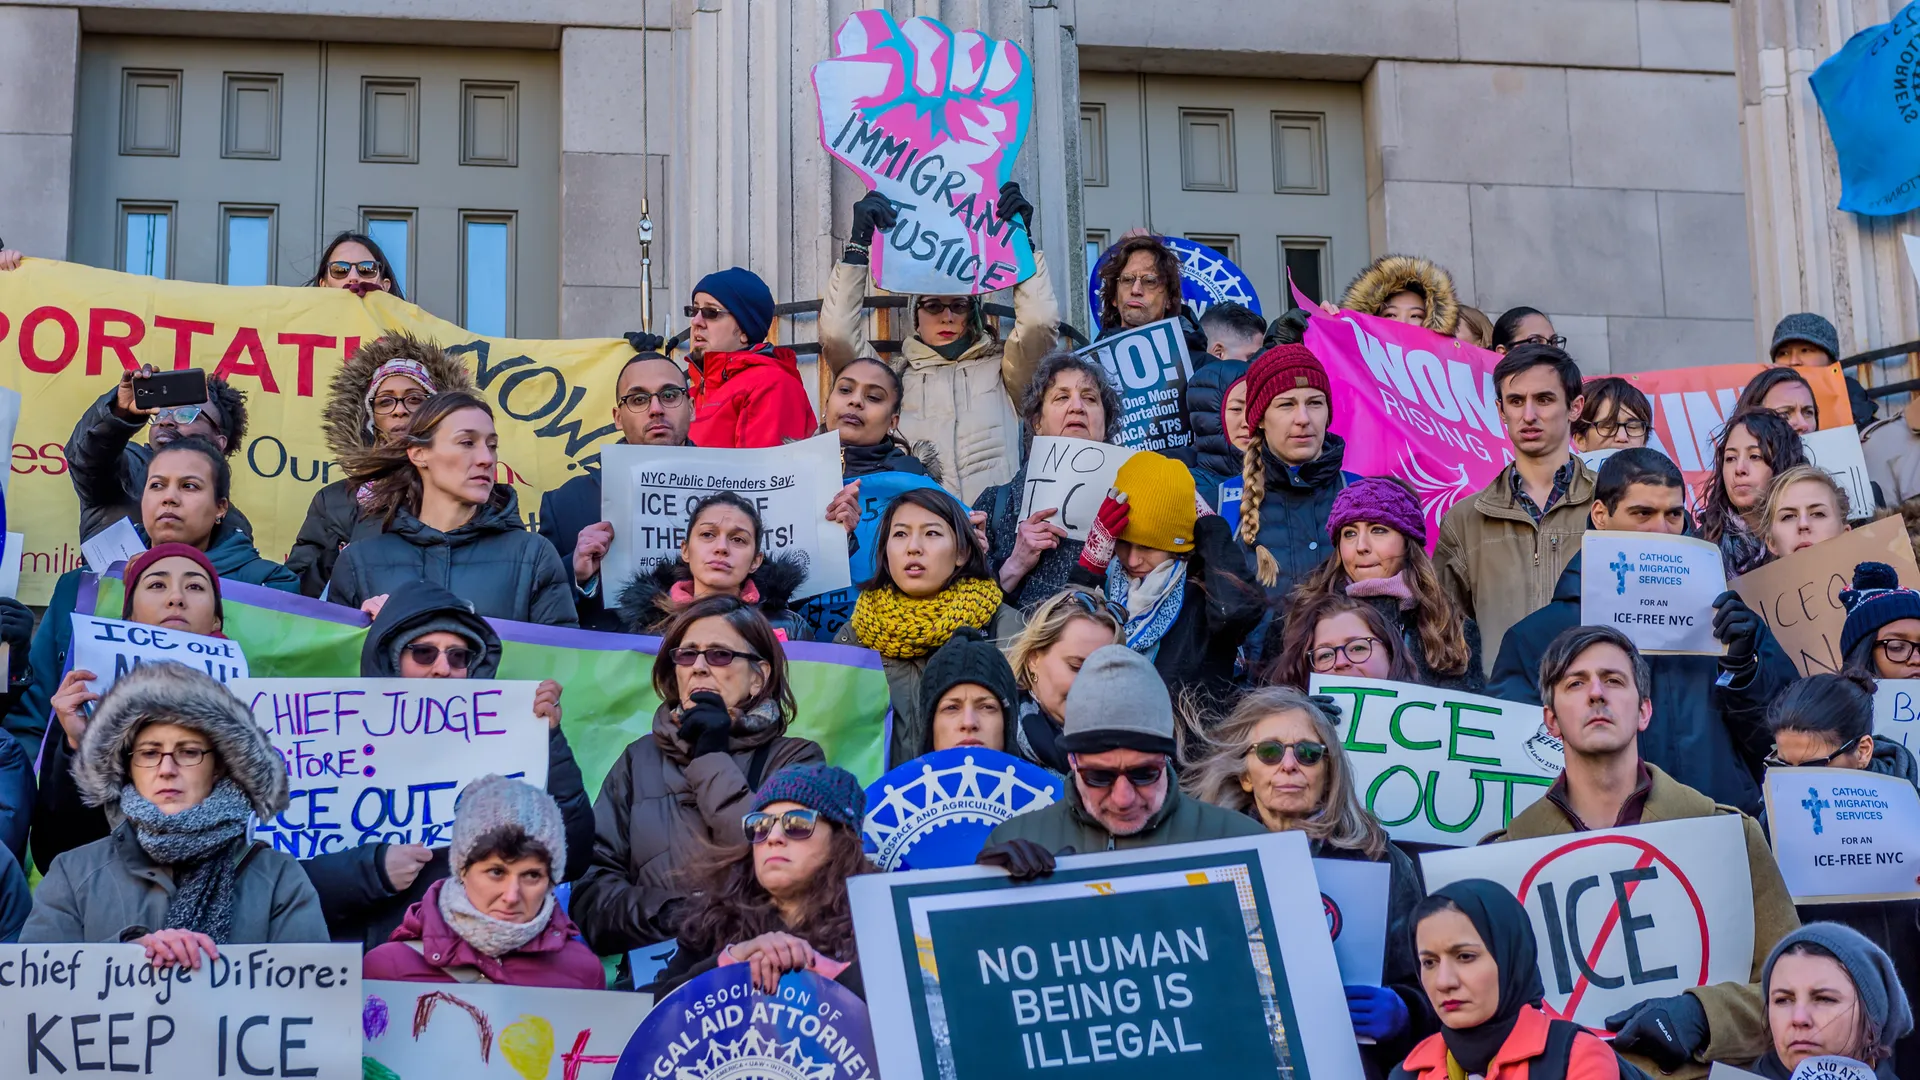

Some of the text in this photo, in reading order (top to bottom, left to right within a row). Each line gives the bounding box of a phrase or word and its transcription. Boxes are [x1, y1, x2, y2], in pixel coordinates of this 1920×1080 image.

[831, 111, 1027, 248] IMMIGRANT
[1121, 387, 1180, 410] One More
[1148, 422, 1160, 436] &
[1160, 417, 1182, 434] TPS
[1377, 388, 1493, 463] RISING
[1166, 429, 1192, 448] Stay!
[1042, 442, 1105, 473] NO
[641, 472, 796, 490] NYC Public Defenders Say:
[641, 492, 677, 516] ICE
[641, 526, 686, 550] THE
[1639, 552, 1684, 564] CATHOLIC
[1639, 563, 1690, 576] MIGRATION
[1638, 575, 1682, 587] SERVICES
[1640, 598, 1669, 608] FOR AN
[1613, 612, 1694, 627] ICE-FREE NYC
[91, 620, 235, 659] ICE out
[250, 689, 507, 743] CHIEF JUDGE
[1318, 686, 1503, 766] ICE
[1365, 765, 1555, 834] OUT
[1832, 787, 1879, 798] CATHOLIC
[1834, 799, 1889, 809] MIGRATION
[351, 780, 458, 833] OUT
[916, 808, 939, 825] AND
[1836, 811, 1884, 821] SERVICES
[273, 829, 348, 858] NYC
[1841, 836, 1873, 845] FOR AN
[1814, 852, 1904, 867] ICE-FREE NYC
[1537, 865, 1679, 995] ICE
[977, 926, 1209, 986] NO HUMAN
[0, 948, 84, 990] chief
[210, 949, 349, 991] DiFiore:
[1011, 972, 1194, 1026] BEING IS
[818, 1002, 842, 1022] OF
[26, 1012, 319, 1078] KEEP ICE
[645, 1031, 700, 1080] GAL
[701, 1005, 744, 1040] AID
[1022, 1016, 1203, 1069] ILLEGAL
